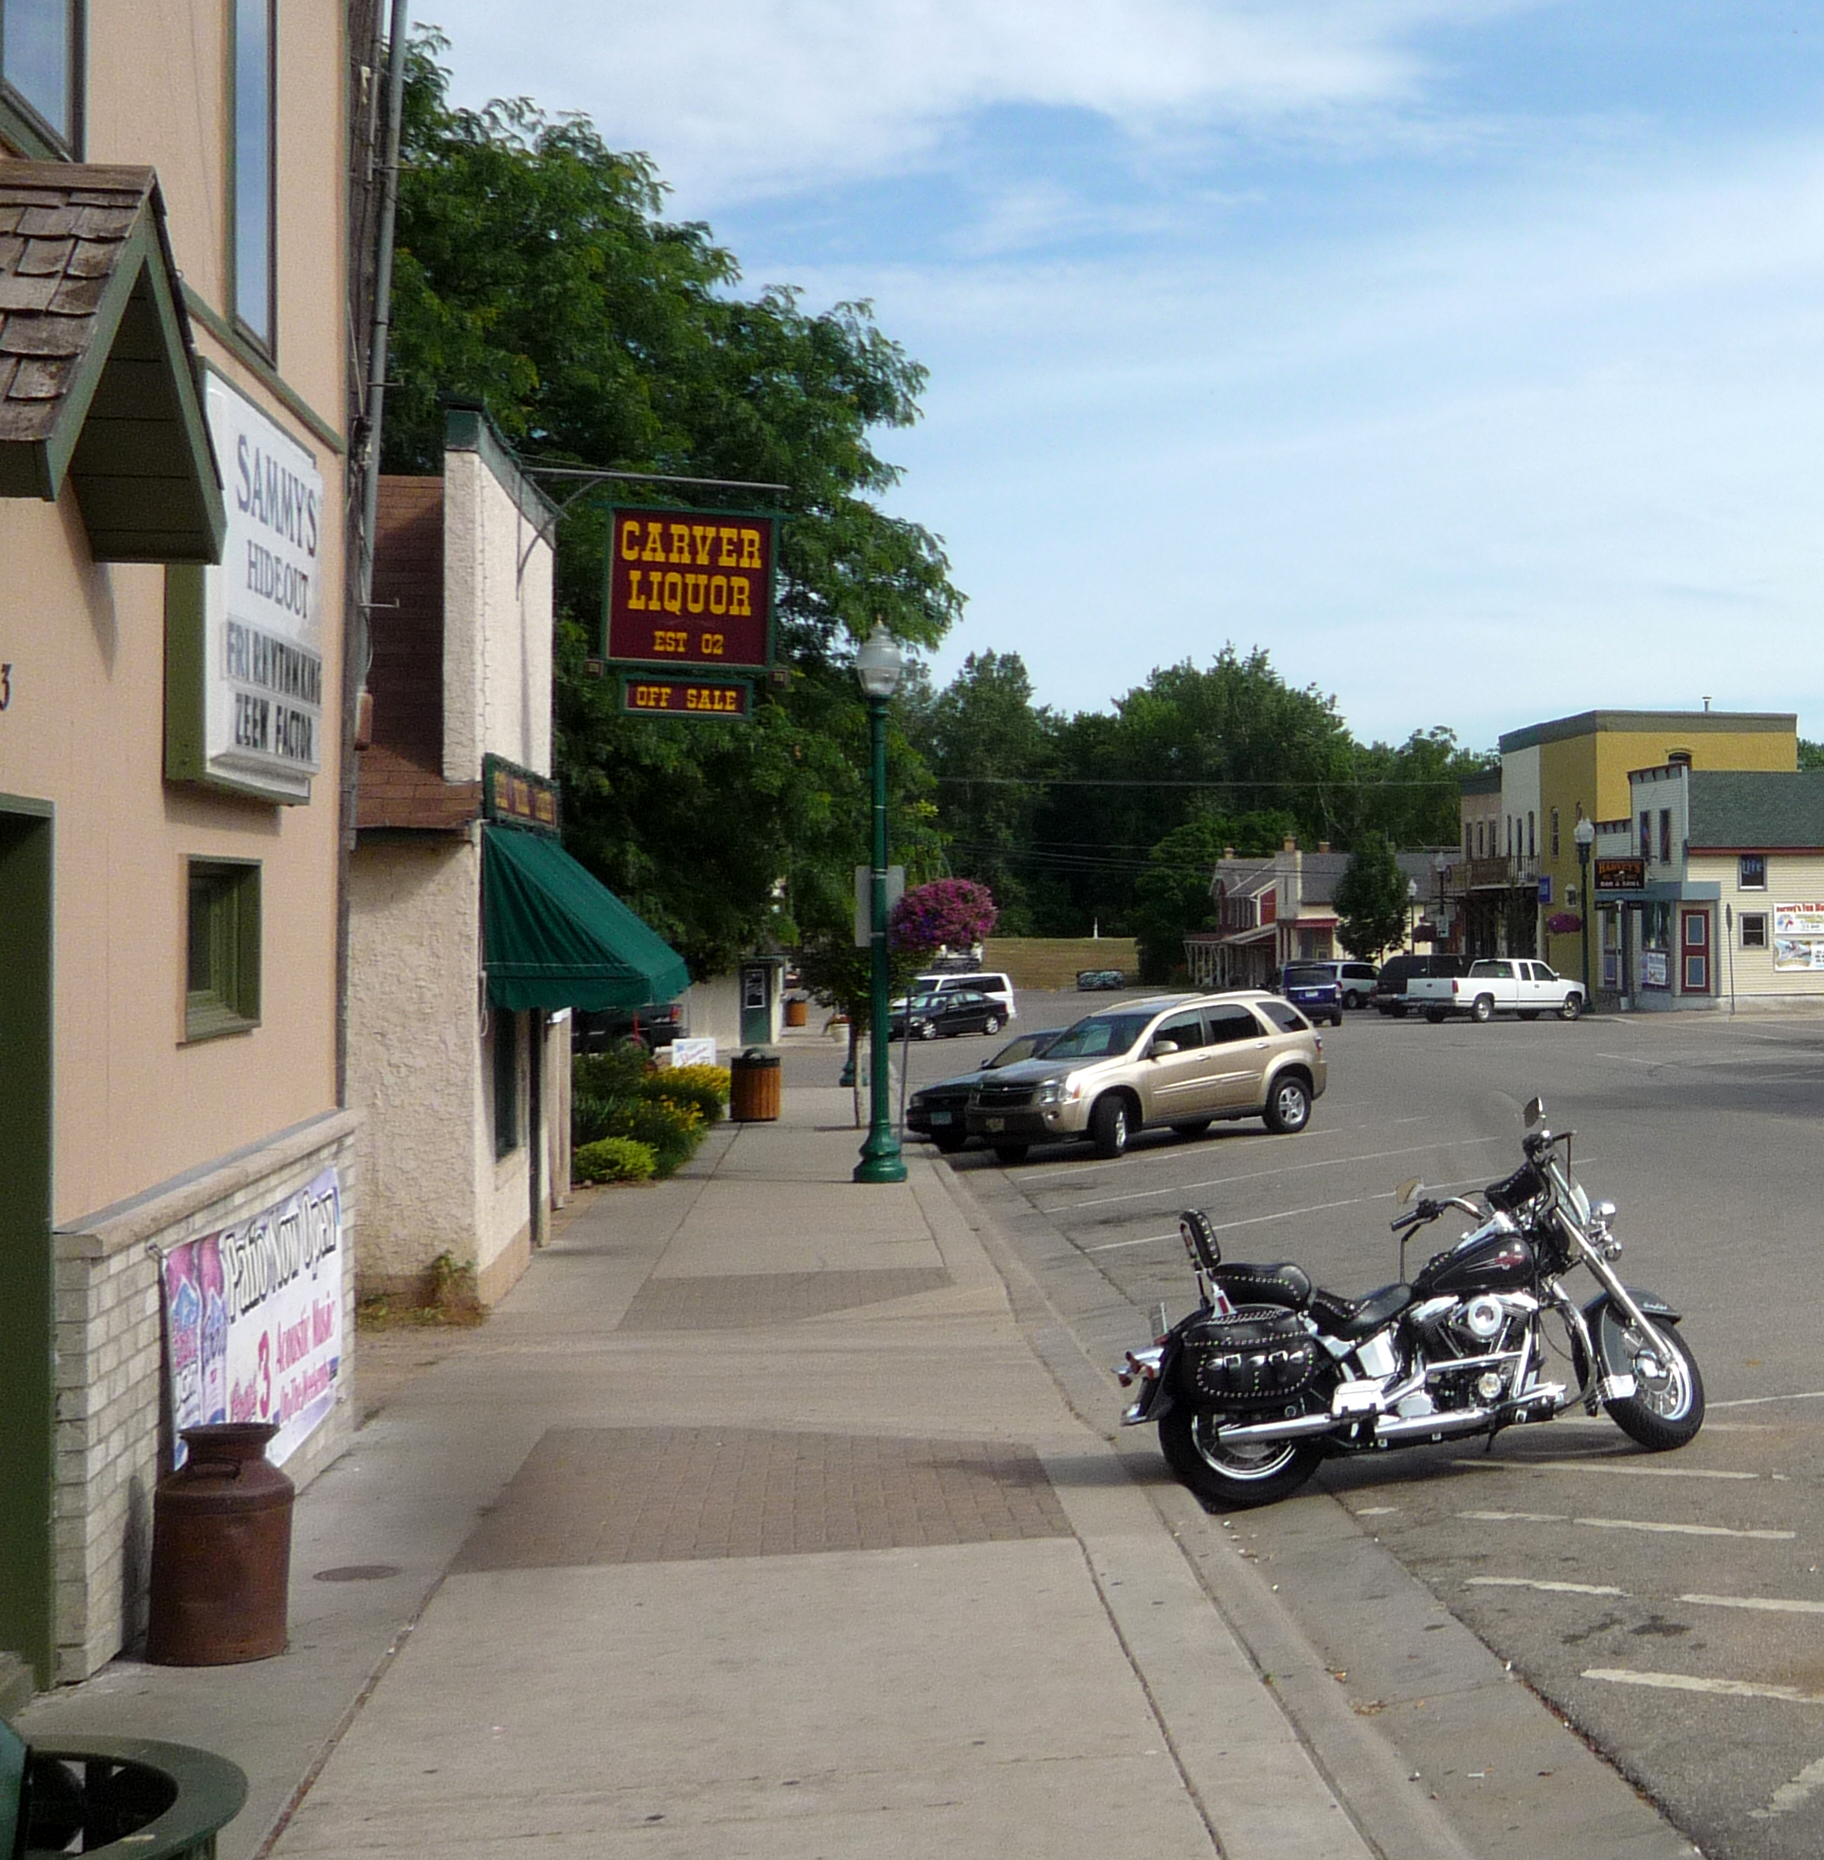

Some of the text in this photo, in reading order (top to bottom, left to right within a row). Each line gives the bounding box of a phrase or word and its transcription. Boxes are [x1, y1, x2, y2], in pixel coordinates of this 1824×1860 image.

[621, 520, 762, 569] CARVER
[246, 539, 309, 620] HIDEOUT
[627, 570, 752, 616] LIQUOR
[653, 631, 688, 652] EST
[635, 686, 737, 711] OFF SALE
